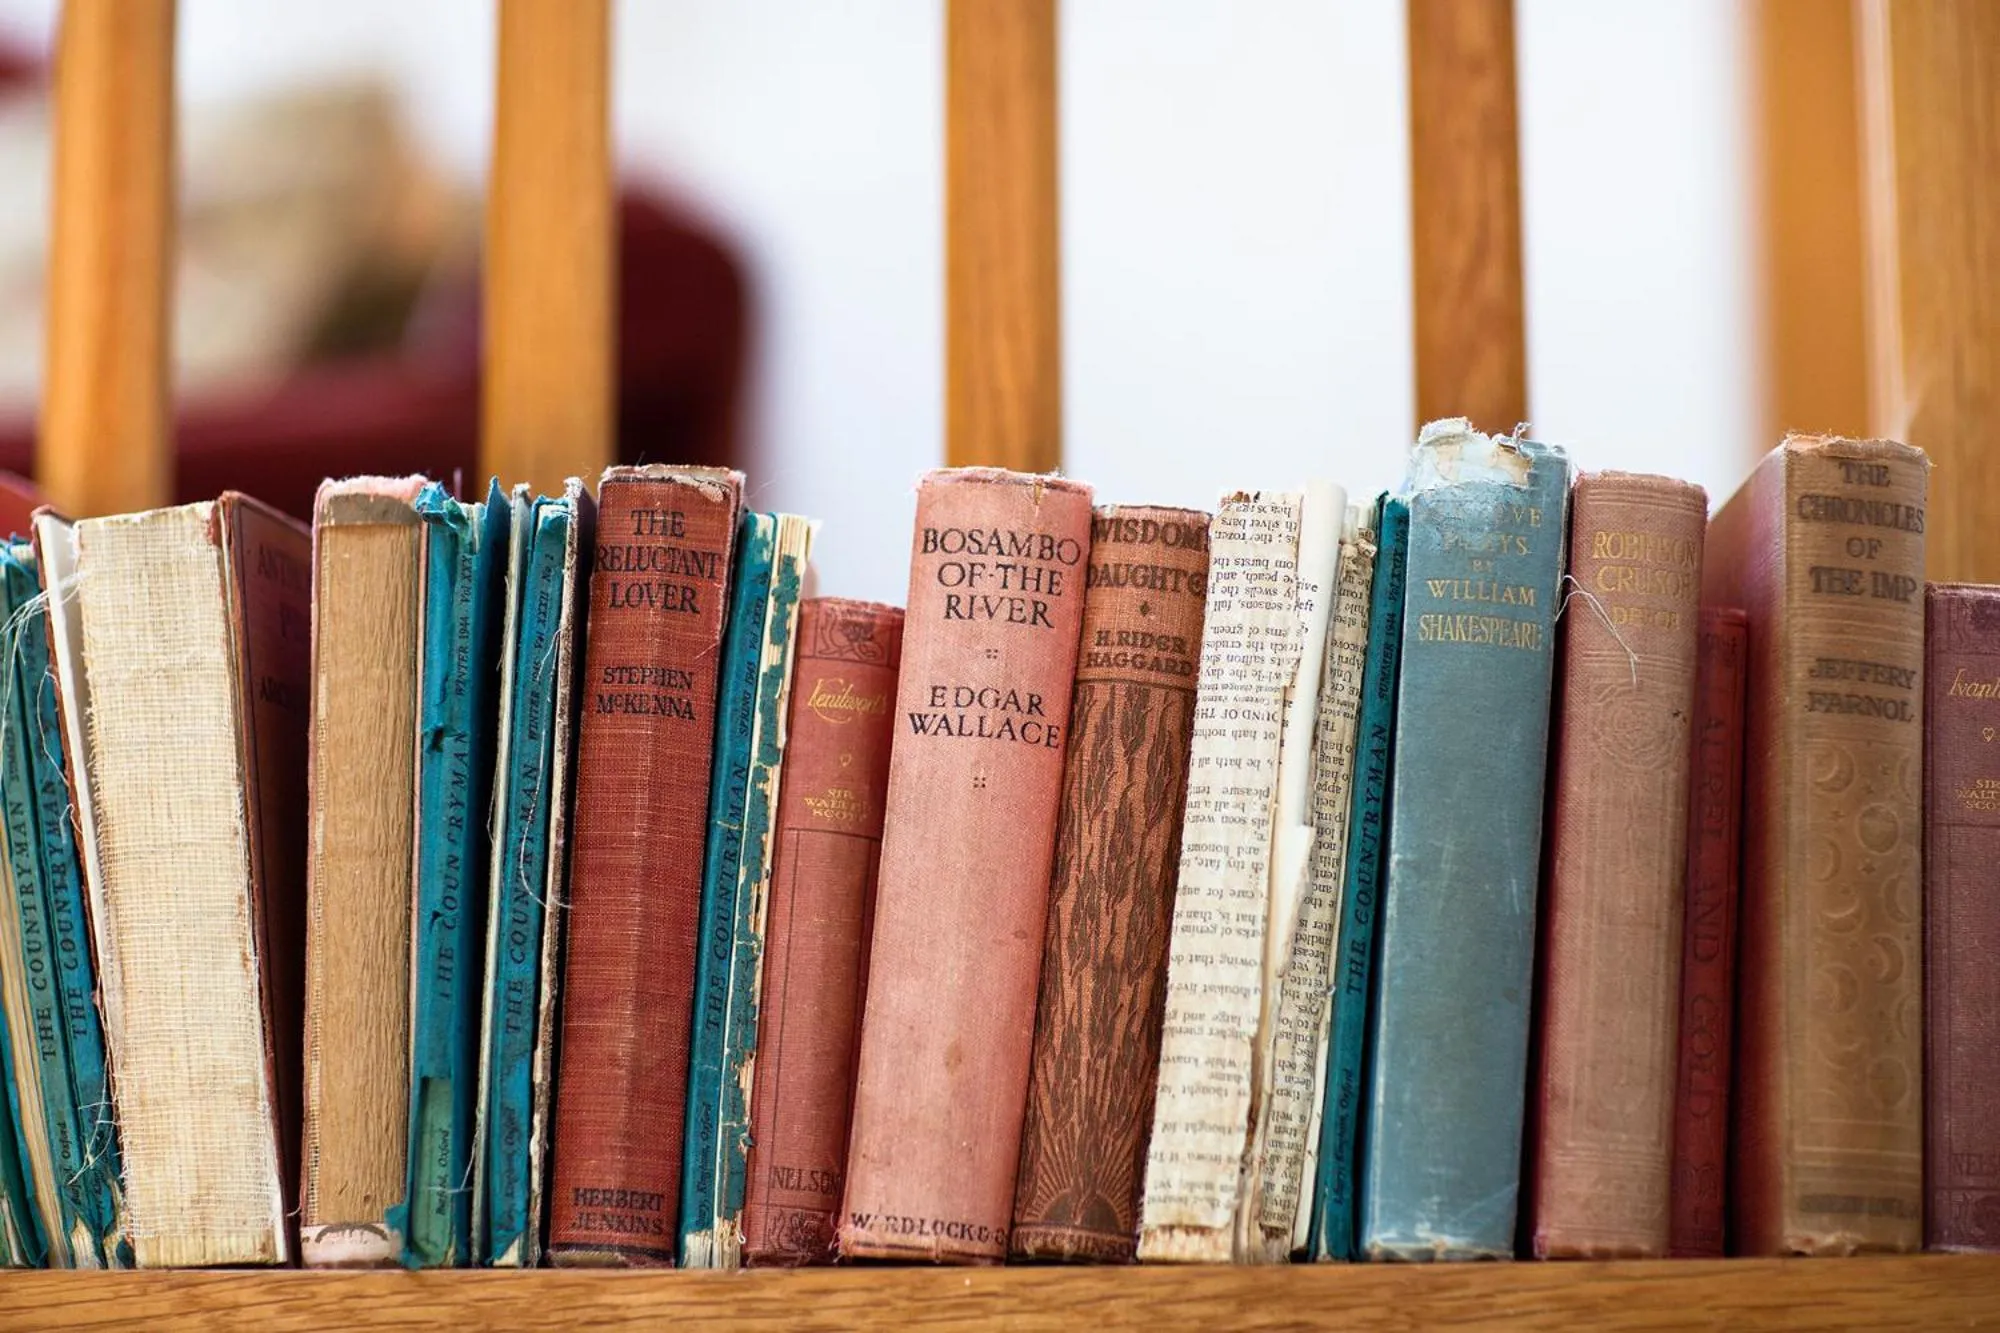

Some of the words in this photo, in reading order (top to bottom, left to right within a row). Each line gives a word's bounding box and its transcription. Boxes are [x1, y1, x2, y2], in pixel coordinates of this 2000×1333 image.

[1839, 461, 1891, 488] THE
[631, 508, 685, 538] THE
[1221, 517, 1247, 530] bars
[1250, 518, 1280, 532] silver
[1797, 494, 1924, 534] CHRONICLES
[921, 526, 1081, 567] BOSAMBO
[1846, 537, 1882, 560] OF
[595, 543, 722, 580] RELUCTANT
[1234, 557, 1269, 570] bursts
[937, 562, 986, 588] OF
[995, 563, 1063, 597] THE
[1216, 570, 1238, 583] and
[1242, 569, 1278, 585] peach,
[1809, 566, 1866, 597] THE
[1871, 570, 1918, 602] IMP
[609, 582, 701, 615] LOVER
[1220, 585, 1239, 598] the
[1245, 586, 1279, 599] swells
[1425, 578, 1537, 607] WILLIAM
[943, 593, 1055, 629] RIVER
[1213, 600, 1232, 612] full
[458, 615, 471, 641] 1944
[1210, 622, 1244, 637] green.
[1248, 626, 1260, 639] of
[1246, 640, 1265, 653] the
[454, 647, 471, 697] WINTER
[1086, 651, 1194, 677] HAGGARD
[1205, 666, 1225, 680] day
[1228, 669, 1247, 681] the
[1378, 643, 1395, 700] SUMMER
[1808, 657, 1916, 690] JEFFERY
[602, 666, 694, 690] STEPHEN
[739, 691, 752, 737] SPRING
[929, 685, 1046, 717] EDGAR
[1805, 691, 1914, 724] FARNOL
[527, 690, 541, 741] WINTER
[907, 712, 1060, 749] WALLACE
[1198, 757, 1211, 769] all
[1215, 757, 1241, 770] hath
[1221, 786, 1270, 801] pleasure
[1214, 801, 1230, 813] all
[1220, 815, 1248, 826] soon
[1354, 722, 1389, 926] COUNTRYMAN
[509, 763, 541, 966] COUNTRYMAN
[713, 765, 747, 961] COUNTRYMAN
[1194, 856, 1221, 872] fate,
[1227, 857, 1246, 873] thy
[1236, 846, 1260, 858] and
[40, 780, 79, 972] COUNTRYMAN
[9, 800, 48, 992] COUNTRYMAN
[1206, 887, 1224, 901] for
[1228, 889, 1255, 901] care
[1186, 910, 1213, 924] than
[1221, 927, 1233, 938] of
[1189, 953, 1214, 967] that
[1346, 939, 1368, 996] THE
[67, 986, 89, 1040] THE
[504, 977, 524, 1035] THE
[705, 974, 726, 1036] THE
[36, 1006, 58, 1062] THE
[771, 1166, 841, 1195] NELSON
[571, 1187, 665, 1213] HERBERT
[571, 1213, 664, 1236] JENKINS
